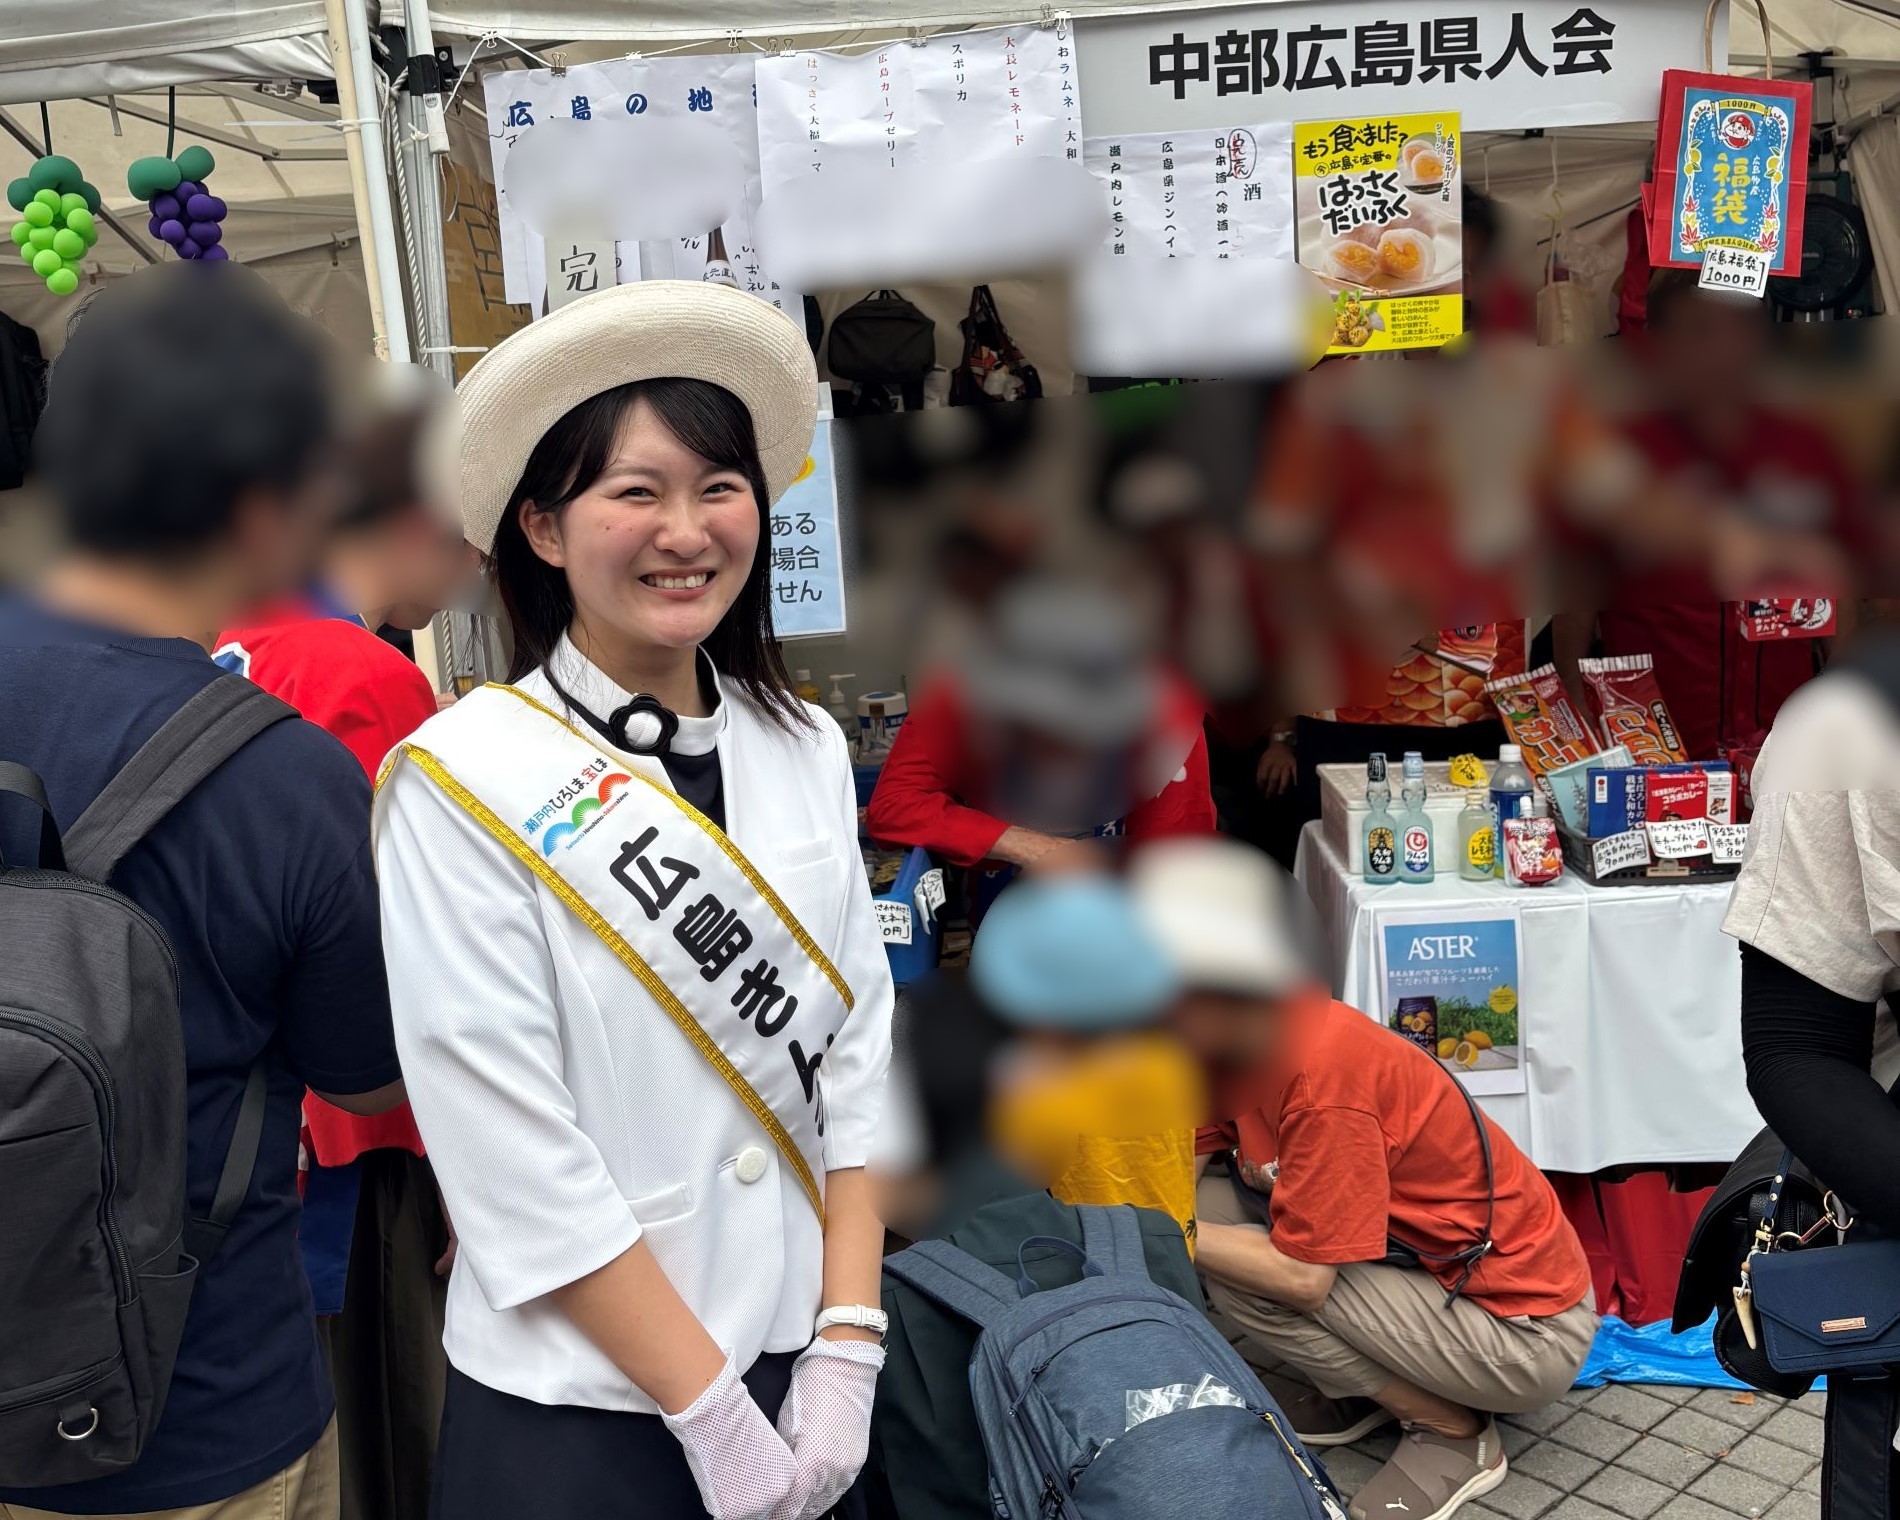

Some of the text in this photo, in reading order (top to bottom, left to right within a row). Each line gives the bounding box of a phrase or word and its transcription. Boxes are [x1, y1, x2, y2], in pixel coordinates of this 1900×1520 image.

[1147, 7, 1617, 99] 中部広島県人会
[951, 43, 968, 102] スポリカ
[1004, 36, 1025, 146] 大長レモネード
[508, 83, 758, 127] 広島の地
[1726, 100, 1756, 109] 1000円
[1330, 151, 1392, 170] 広島で定番の
[1243, 182, 1262, 201] 酒
[1319, 170, 1399, 208] はっさく
[1712, 152, 1751, 224] 福袋
[1322, 193, 1409, 235] だいふく
[1709, 249, 1759, 271] 広島福袋
[1706, 266, 1756, 287] 1000円
[770, 511, 817, 535] ある
[770, 545, 820, 571] 場合
[770, 579, 823, 603] せん
[522, 757, 608, 835] 瀬戸内ひろしま、宝しま
[1625, 775, 1636, 832] 戦艦大和カレ
[1726, 847, 1744, 857] 80
[879, 925, 902, 937] 0円
[1408, 935, 1477, 960] ASTER
